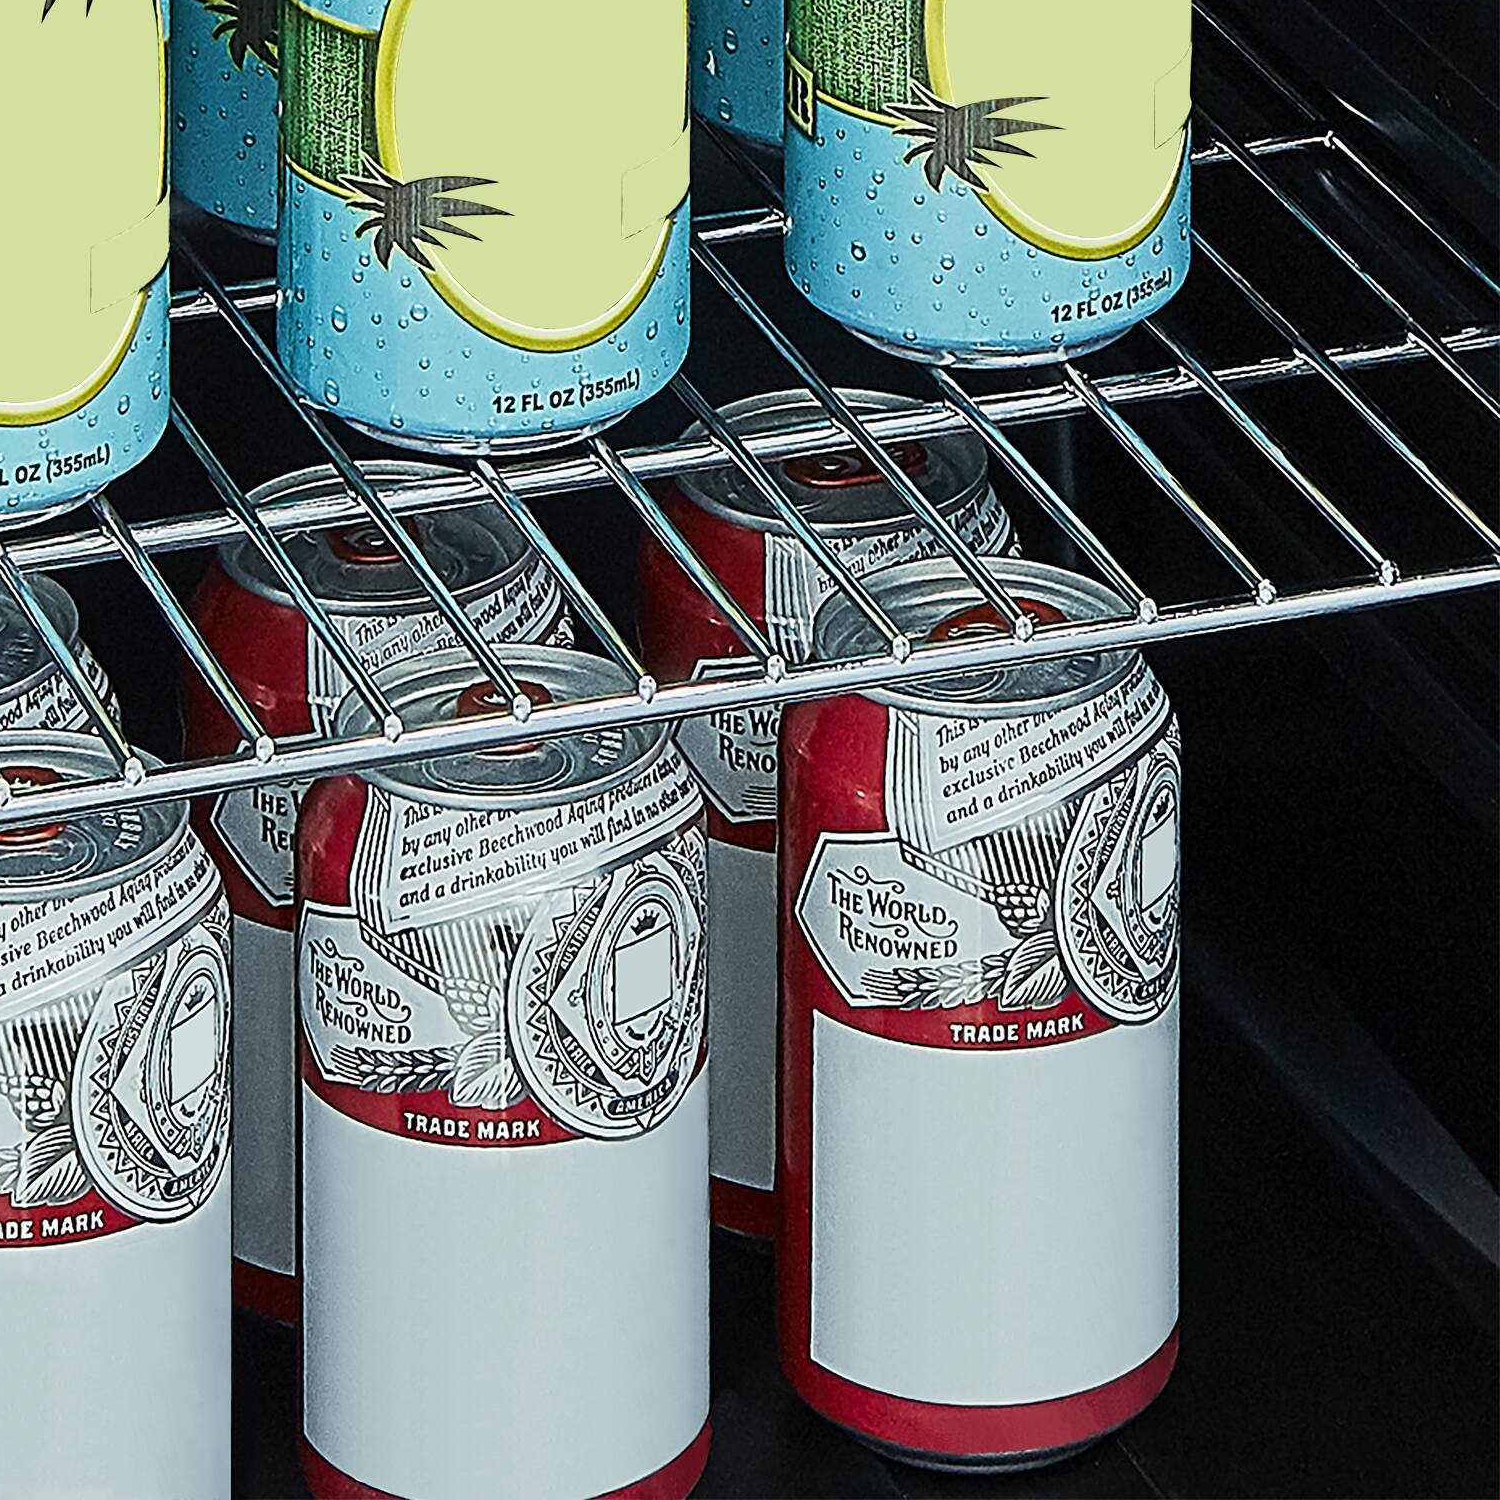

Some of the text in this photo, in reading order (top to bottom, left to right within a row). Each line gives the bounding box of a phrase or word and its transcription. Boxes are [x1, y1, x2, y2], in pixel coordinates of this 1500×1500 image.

[1050, 303, 1072, 322] 12
[1077, 297, 1098, 318] FL
[1101, 289, 1122, 313] OZ
[492, 368, 639, 414] 12 FL OZ (355mL)
[16, 464, 41, 484] OZ
[46, 443, 110, 484] (355mL)
[355, 618, 385, 646] This
[936, 720, 965, 748] This
[939, 719, 1029, 774] by any other
[943, 707, 1092, 798] exclusive Beechwood
[946, 736, 1107, 824] and a drinkability you
[401, 812, 492, 857] by any other
[404, 804, 430, 829] This
[400, 848, 473, 881] exclusive
[479, 808, 563, 858] Beechwood
[400, 883, 430, 908] and
[435, 885, 445, 899] a
[450, 852, 546, 894] drinkability
[551, 840, 578, 865] you
[580, 822, 606, 849] will
[10, 901, 48, 932] other
[36, 891, 116, 950] Beechwood
[827, 872, 952, 931] THE WORLD
[12, 937, 105, 991] drinkability
[107, 921, 133, 948] you
[560, 906, 601, 970] AUSTRALIA
[839, 911, 958, 961] RENOWNED
[308, 941, 406, 1015] THE WORLD
[123, 986, 158, 1056] AUSTRALIA
[316, 982, 412, 1044] RENOWNED
[950, 1013, 1084, 1043] TRADE MARK
[562, 1036, 597, 1077] AFRICA
[615, 1078, 673, 1114] AMERICA
[124, 1120, 155, 1160] AFRICA
[404, 1112, 540, 1140] TRADE MARK
[41, 1210, 104, 1237] MARK
